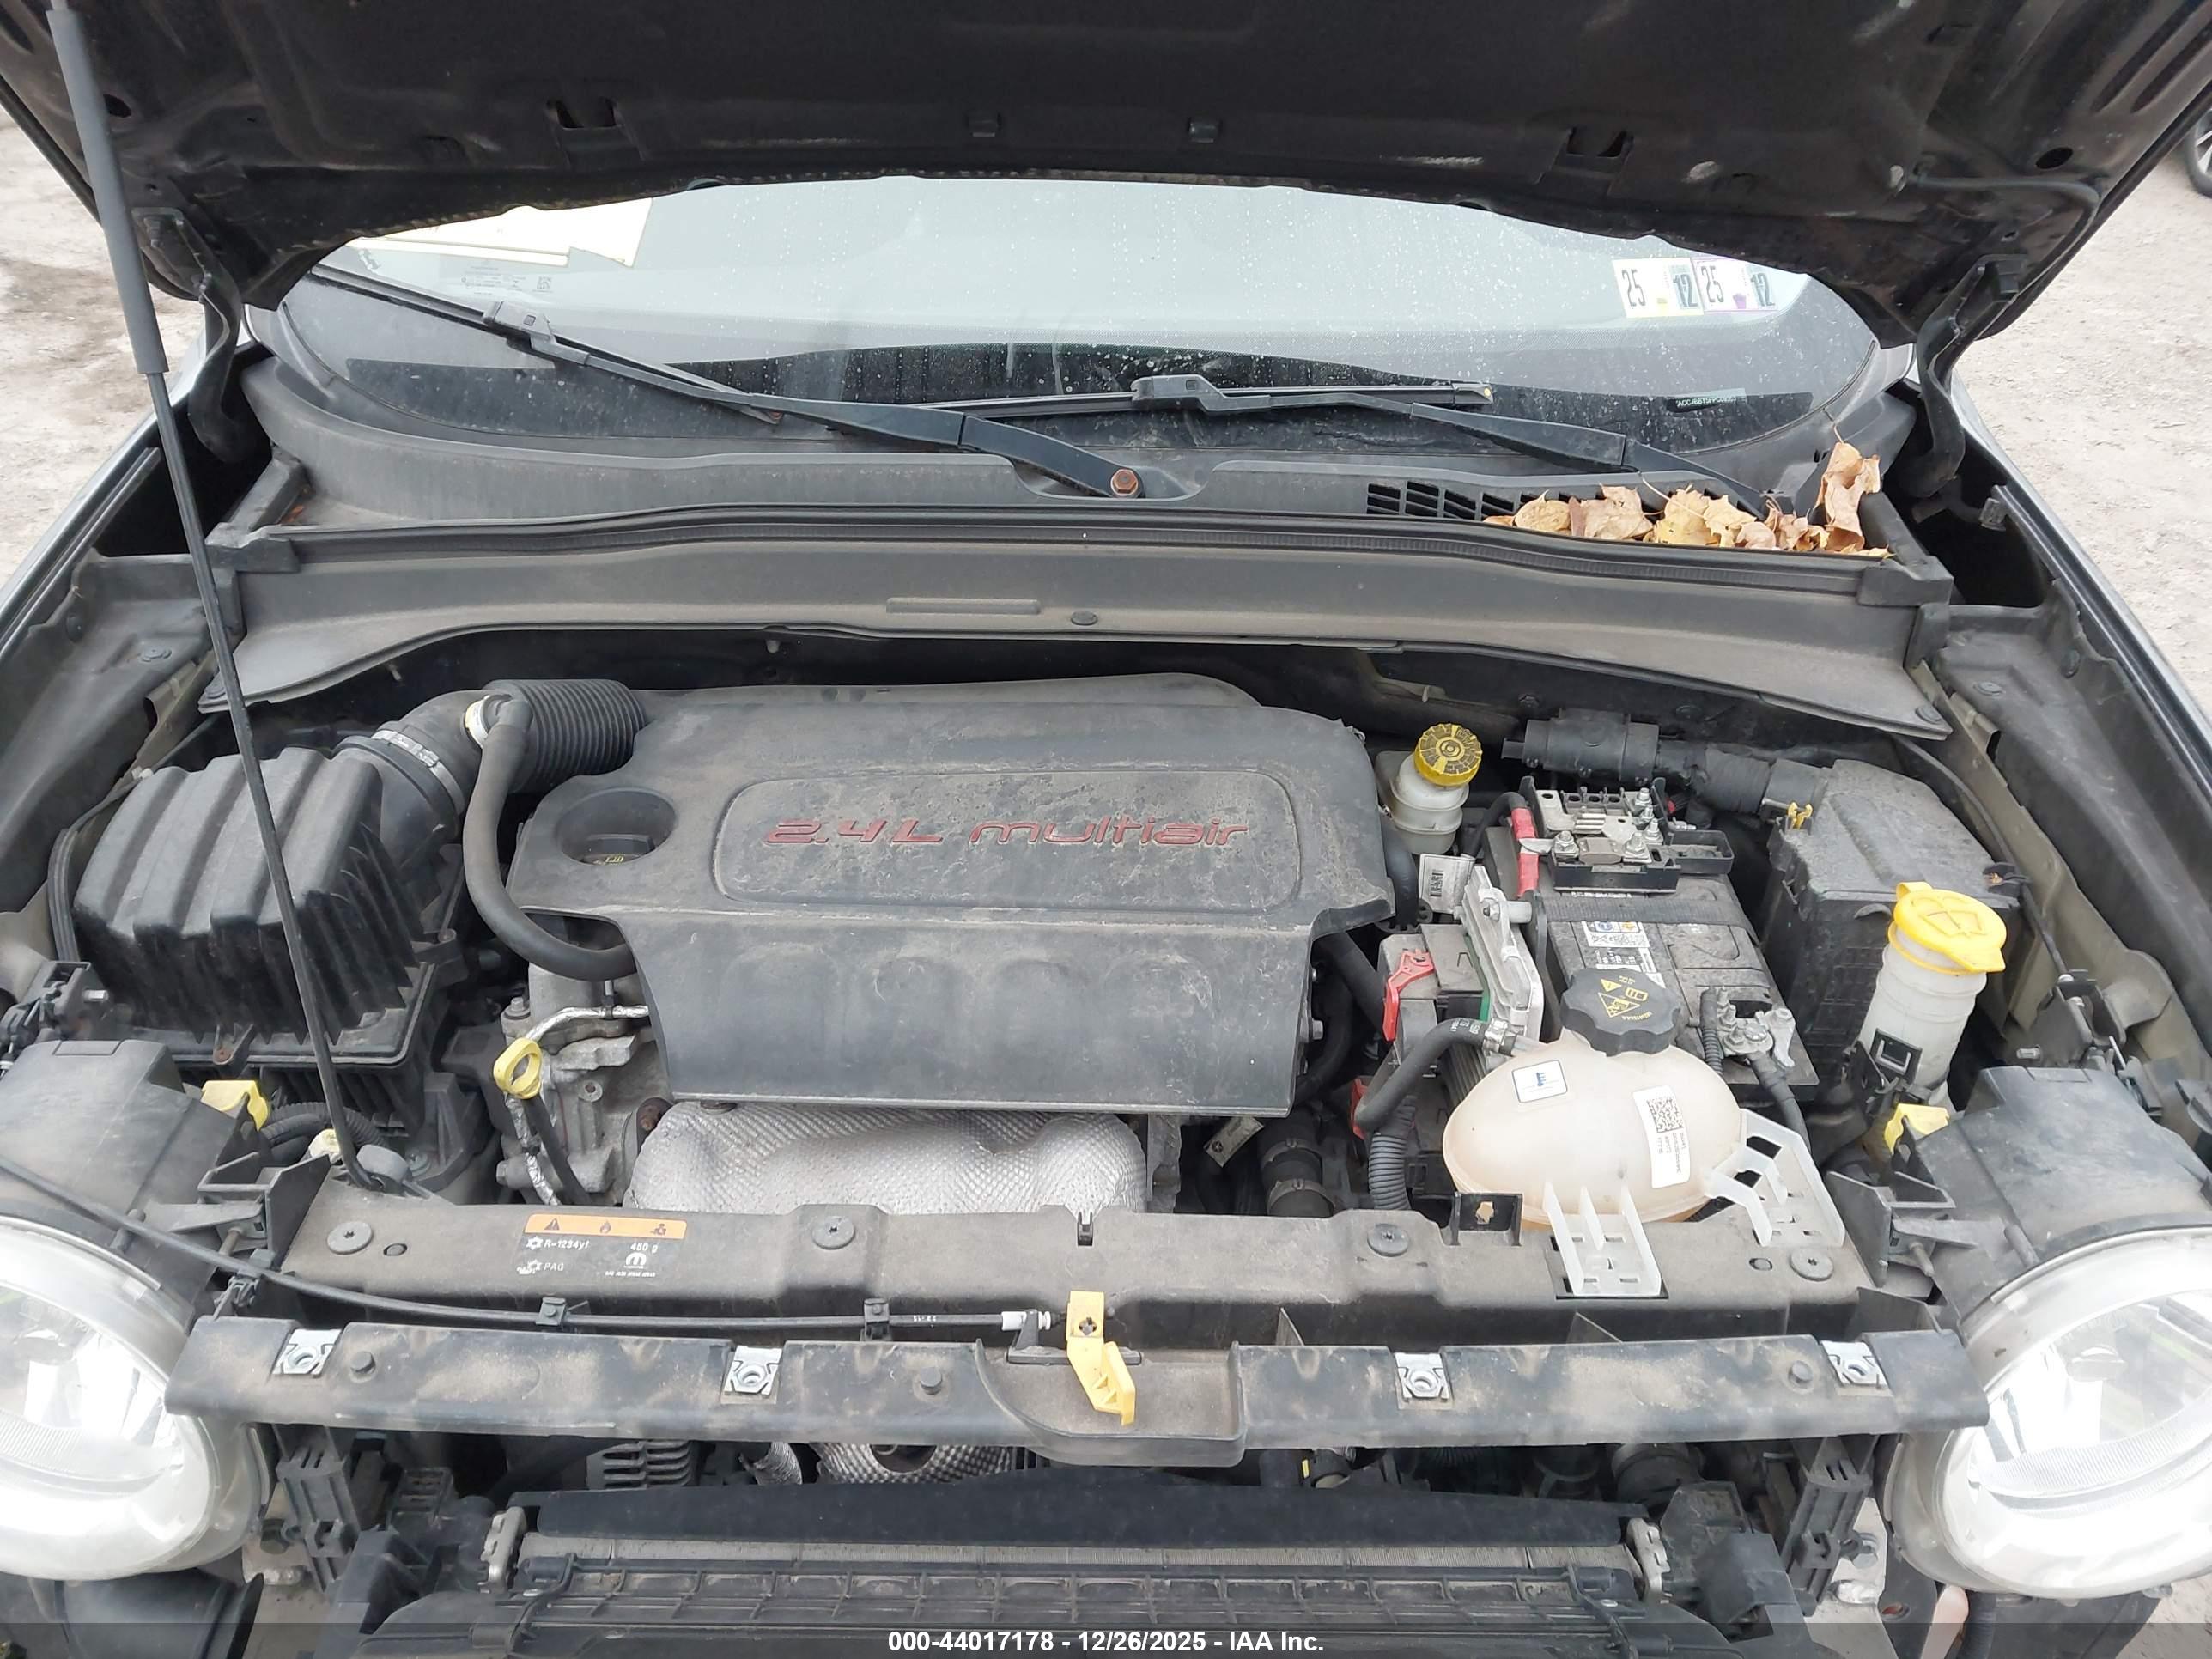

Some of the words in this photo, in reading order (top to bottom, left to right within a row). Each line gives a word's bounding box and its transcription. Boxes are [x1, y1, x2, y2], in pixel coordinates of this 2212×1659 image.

[1621, 269, 1646, 307] 25
[1673, 274, 1698, 307] 12
[1701, 265, 1724, 303] 25
[1750, 272, 1776, 307] 12
[764, 819, 944, 844] 2.4L
[968, 817, 1249, 846] multiair
[544, 1238, 590, 1250] R-1234yf
[544, 1262, 564, 1272] PAG
